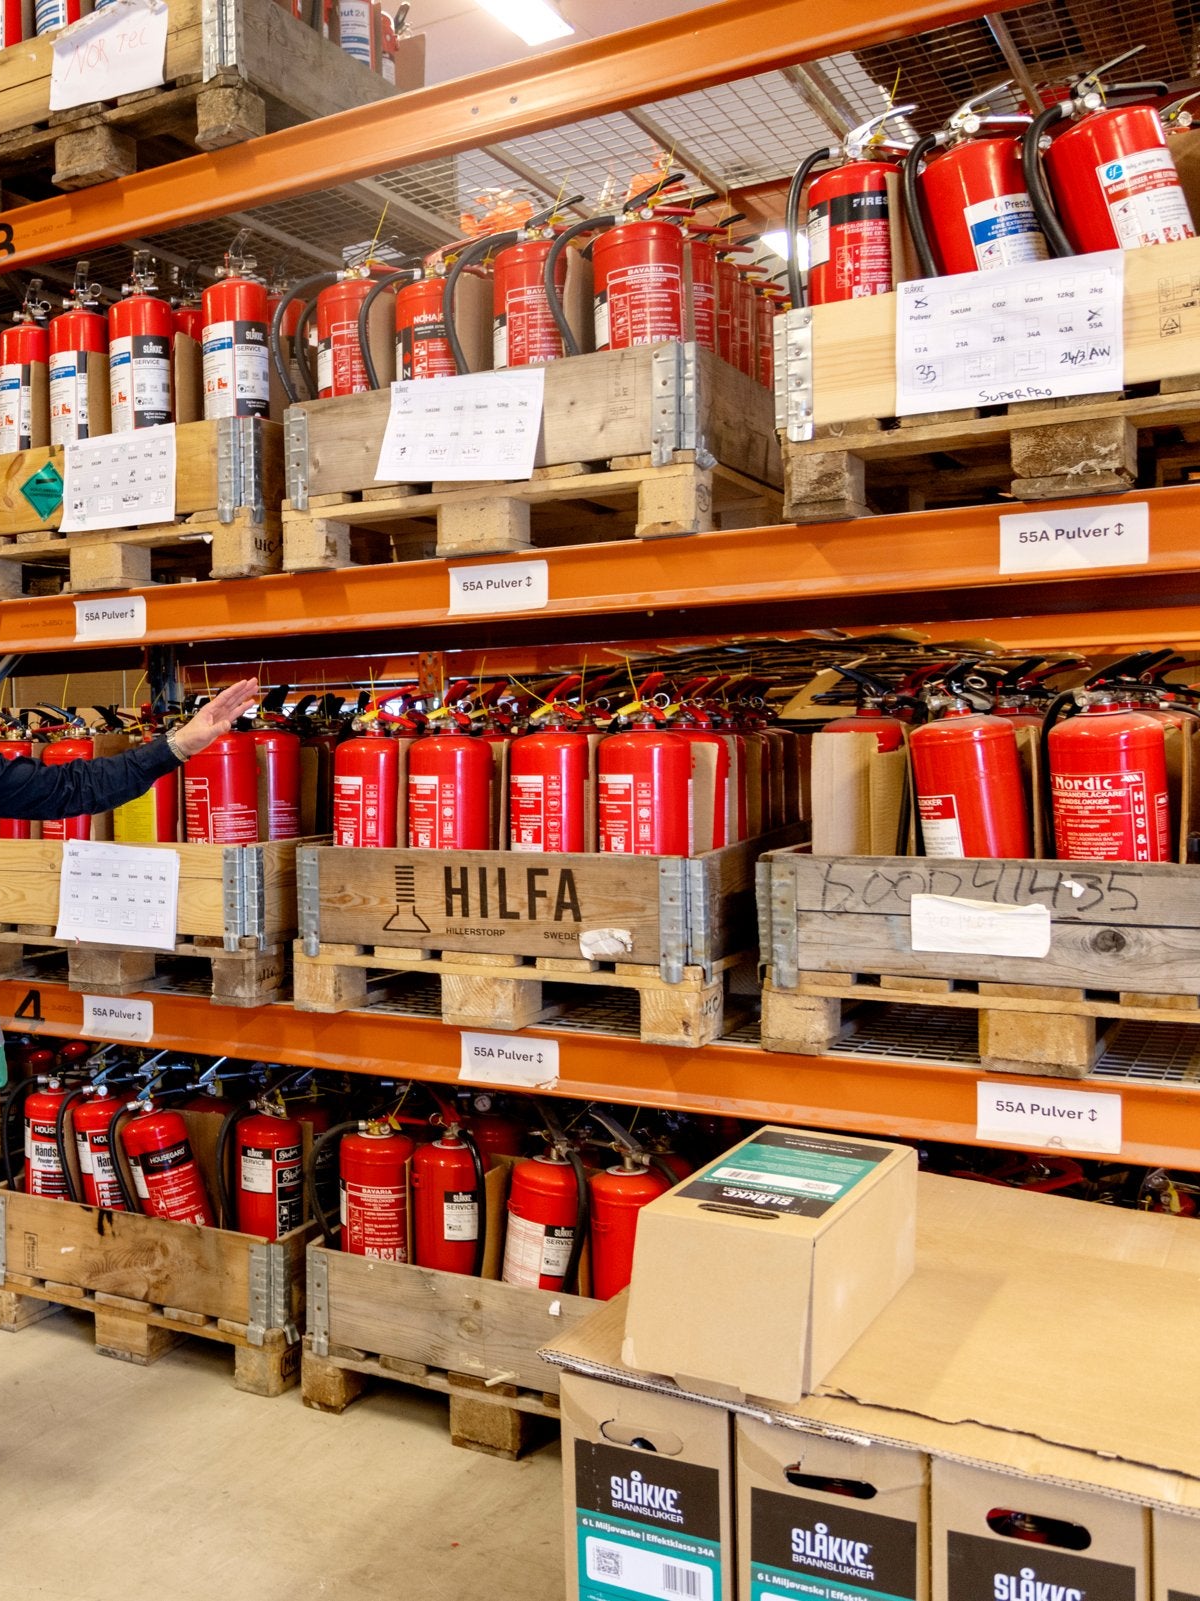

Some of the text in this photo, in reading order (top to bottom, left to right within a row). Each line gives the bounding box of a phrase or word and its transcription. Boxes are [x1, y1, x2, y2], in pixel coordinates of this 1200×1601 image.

[627, 266, 664, 276] BAVARIA
[909, 313, 932, 321] Pulver
[950, 306, 972, 316] SKUM
[1024, 295, 1043, 303] Vann
[1057, 290, 1075, 300] 12kg
[1089, 286, 1103, 295] 2kg
[414, 313, 437, 324] NOHA
[1088, 321, 1103, 330] 55A
[236, 345, 262, 353] SERVICE
[916, 365, 937, 383] 35
[1018, 523, 1110, 544] 55A Pulver
[462, 576, 523, 592] 55A Pulver
[84, 609, 128, 622] 55A Pulver
[1055, 776, 1113, 790] Nordic
[444, 866, 583, 922] HILFA
[446, 927, 506, 937] HILLERSTORP
[14, 989, 45, 1022] 4
[92, 1007, 136, 1020] 55A Pulver
[473, 1046, 534, 1063] 55A Pulver
[995, 1099, 1084, 1120] 55A Pulver
[150, 1147, 185, 1164] HOUSEGARD
[243, 1157, 266, 1166] SERVICE
[611, 1499, 684, 1525] BRANNSLUKKER
[582, 1517, 589, 1526] 6
[589, 1519, 595, 1527] L
[595, 1520, 641, 1539] Miljøvæske
[646, 1533, 697, 1553] Effektklasse
[698, 1545, 715, 1558] 34A
[792, 1553, 875, 1581] BRANNSLUKKER
[757, 1572, 764, 1581] 6
[765, 1574, 771, 1583] L
[772, 1575, 825, 1596] Miljøvæske
